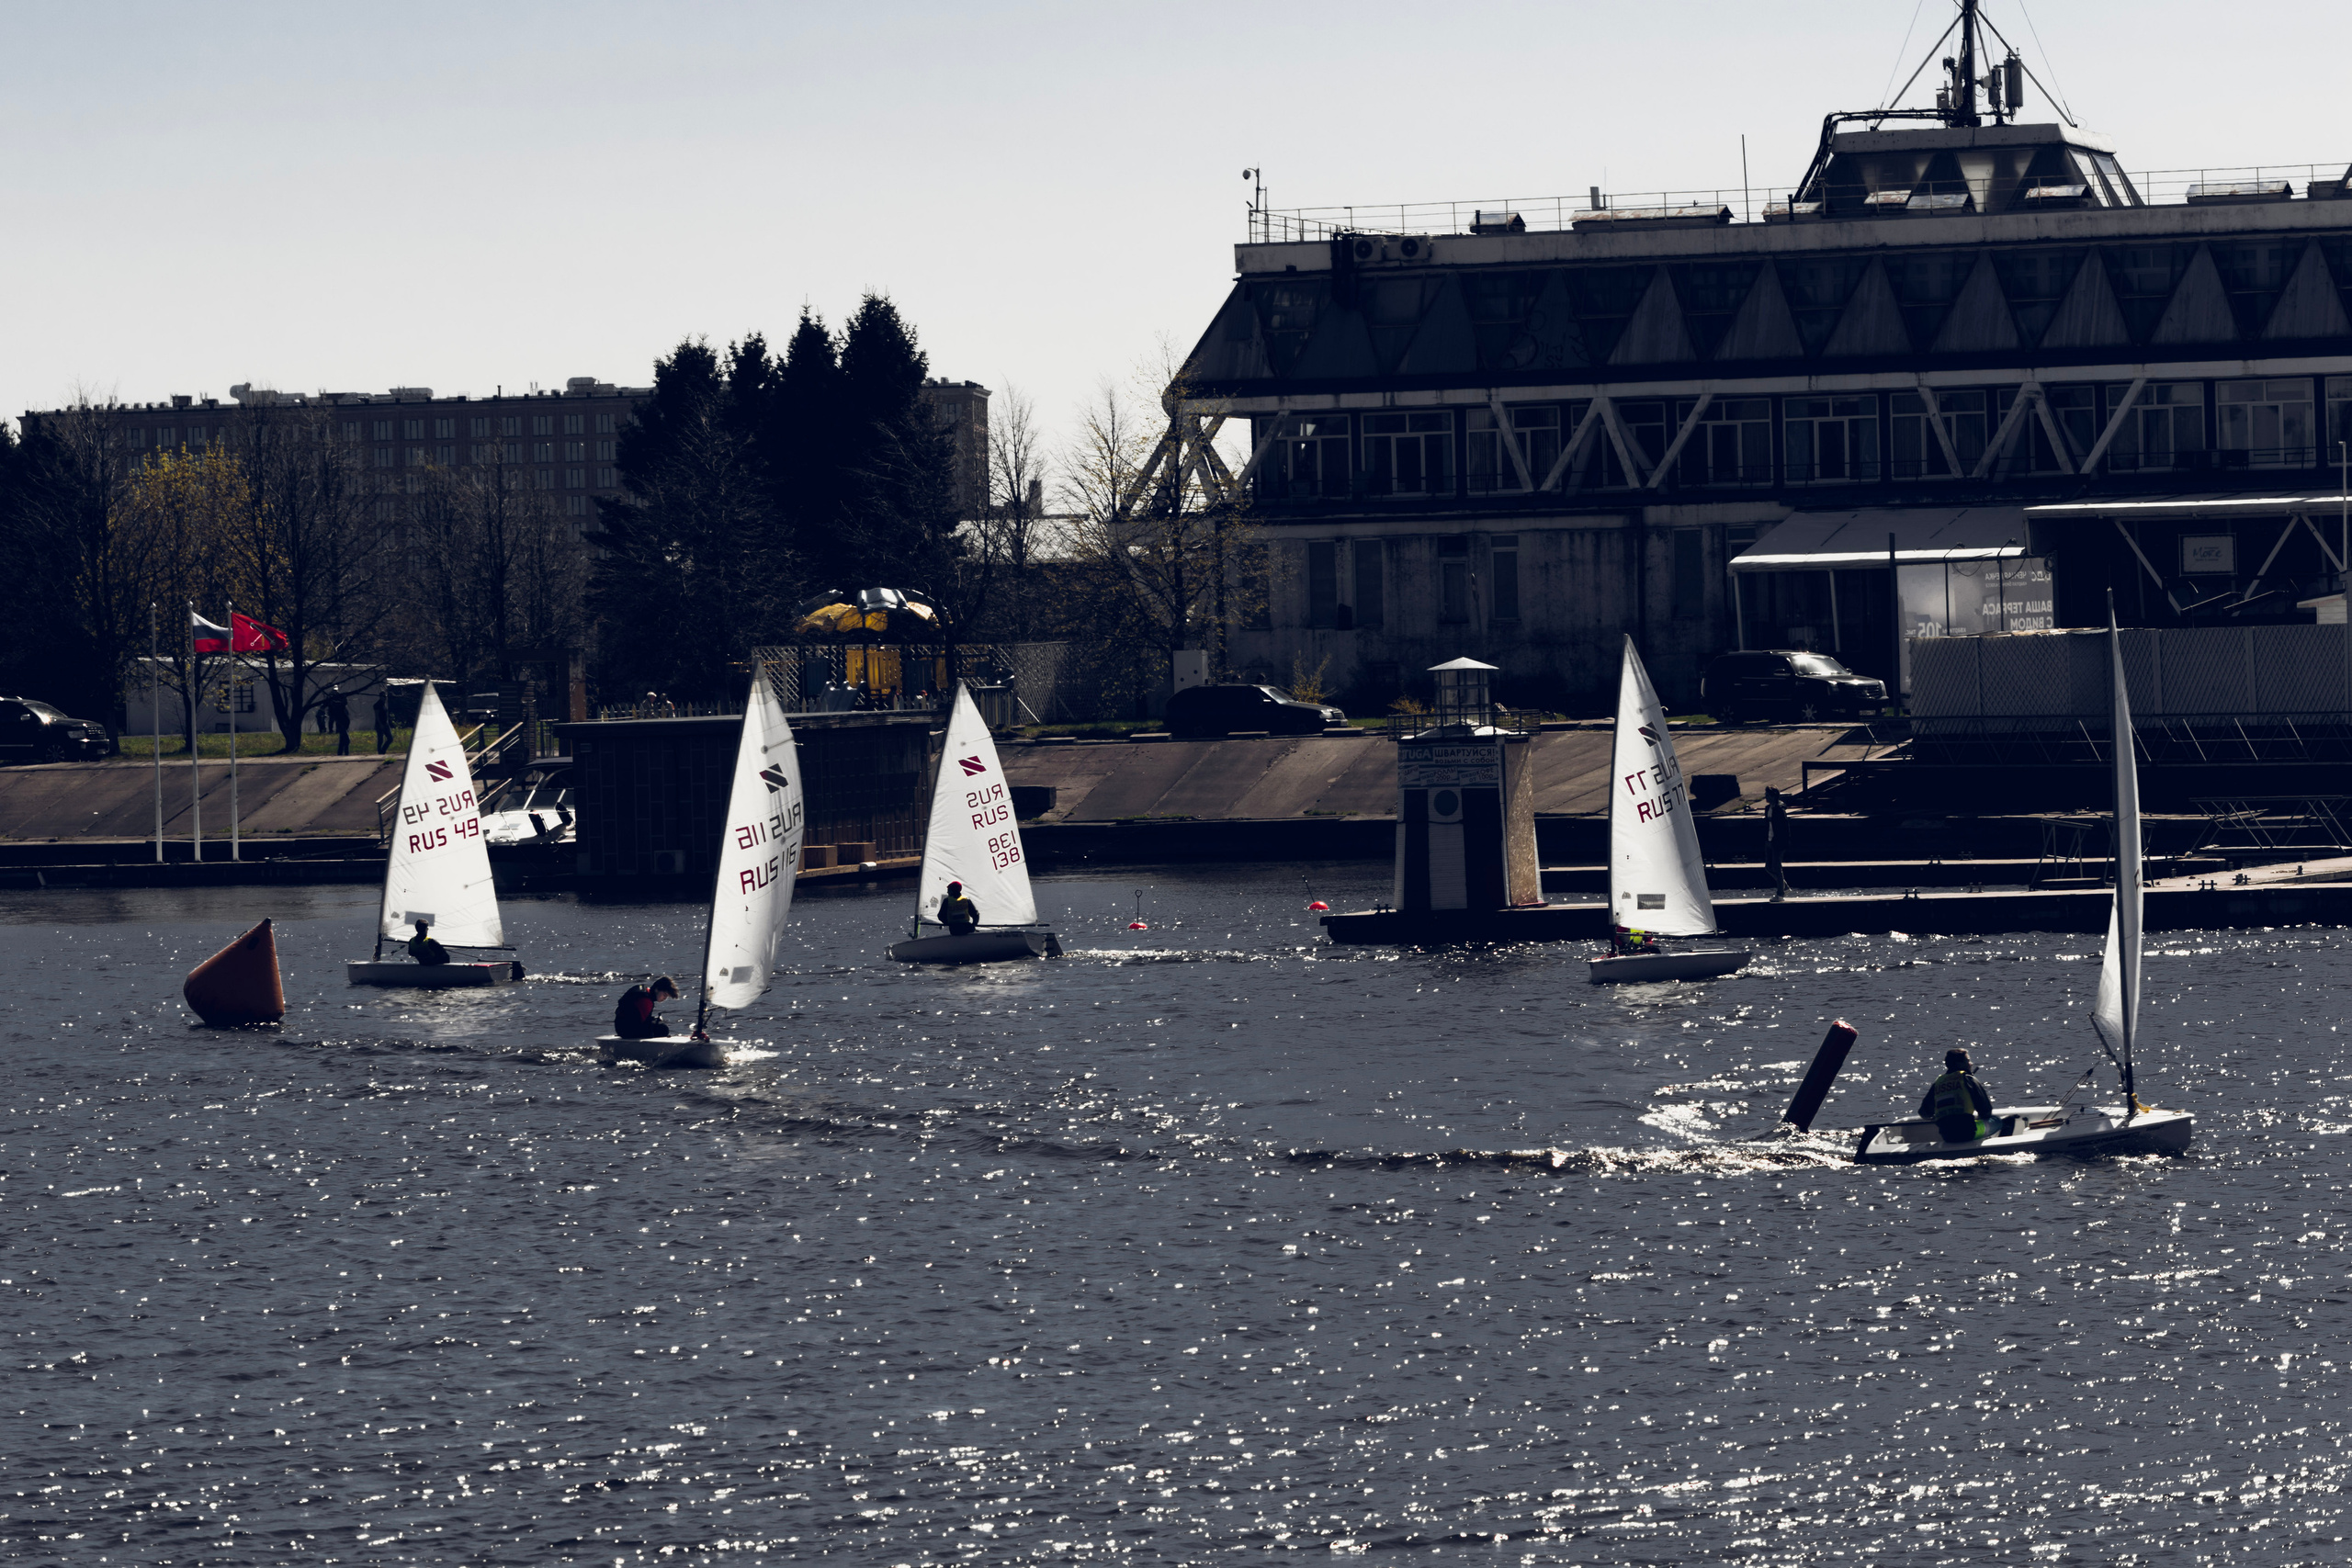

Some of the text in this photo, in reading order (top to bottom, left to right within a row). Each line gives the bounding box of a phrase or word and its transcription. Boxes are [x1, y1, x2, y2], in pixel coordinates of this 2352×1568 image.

[1434, 747, 1495, 758] ШВАРТУЙСЯ!
[971, 804, 1009, 830] RUS
[1636, 782, 1687, 824] RUS 77
[408, 817, 480, 854] RUS 49
[740, 841, 797, 896] RUS 116
[991, 846, 1021, 871] 138
